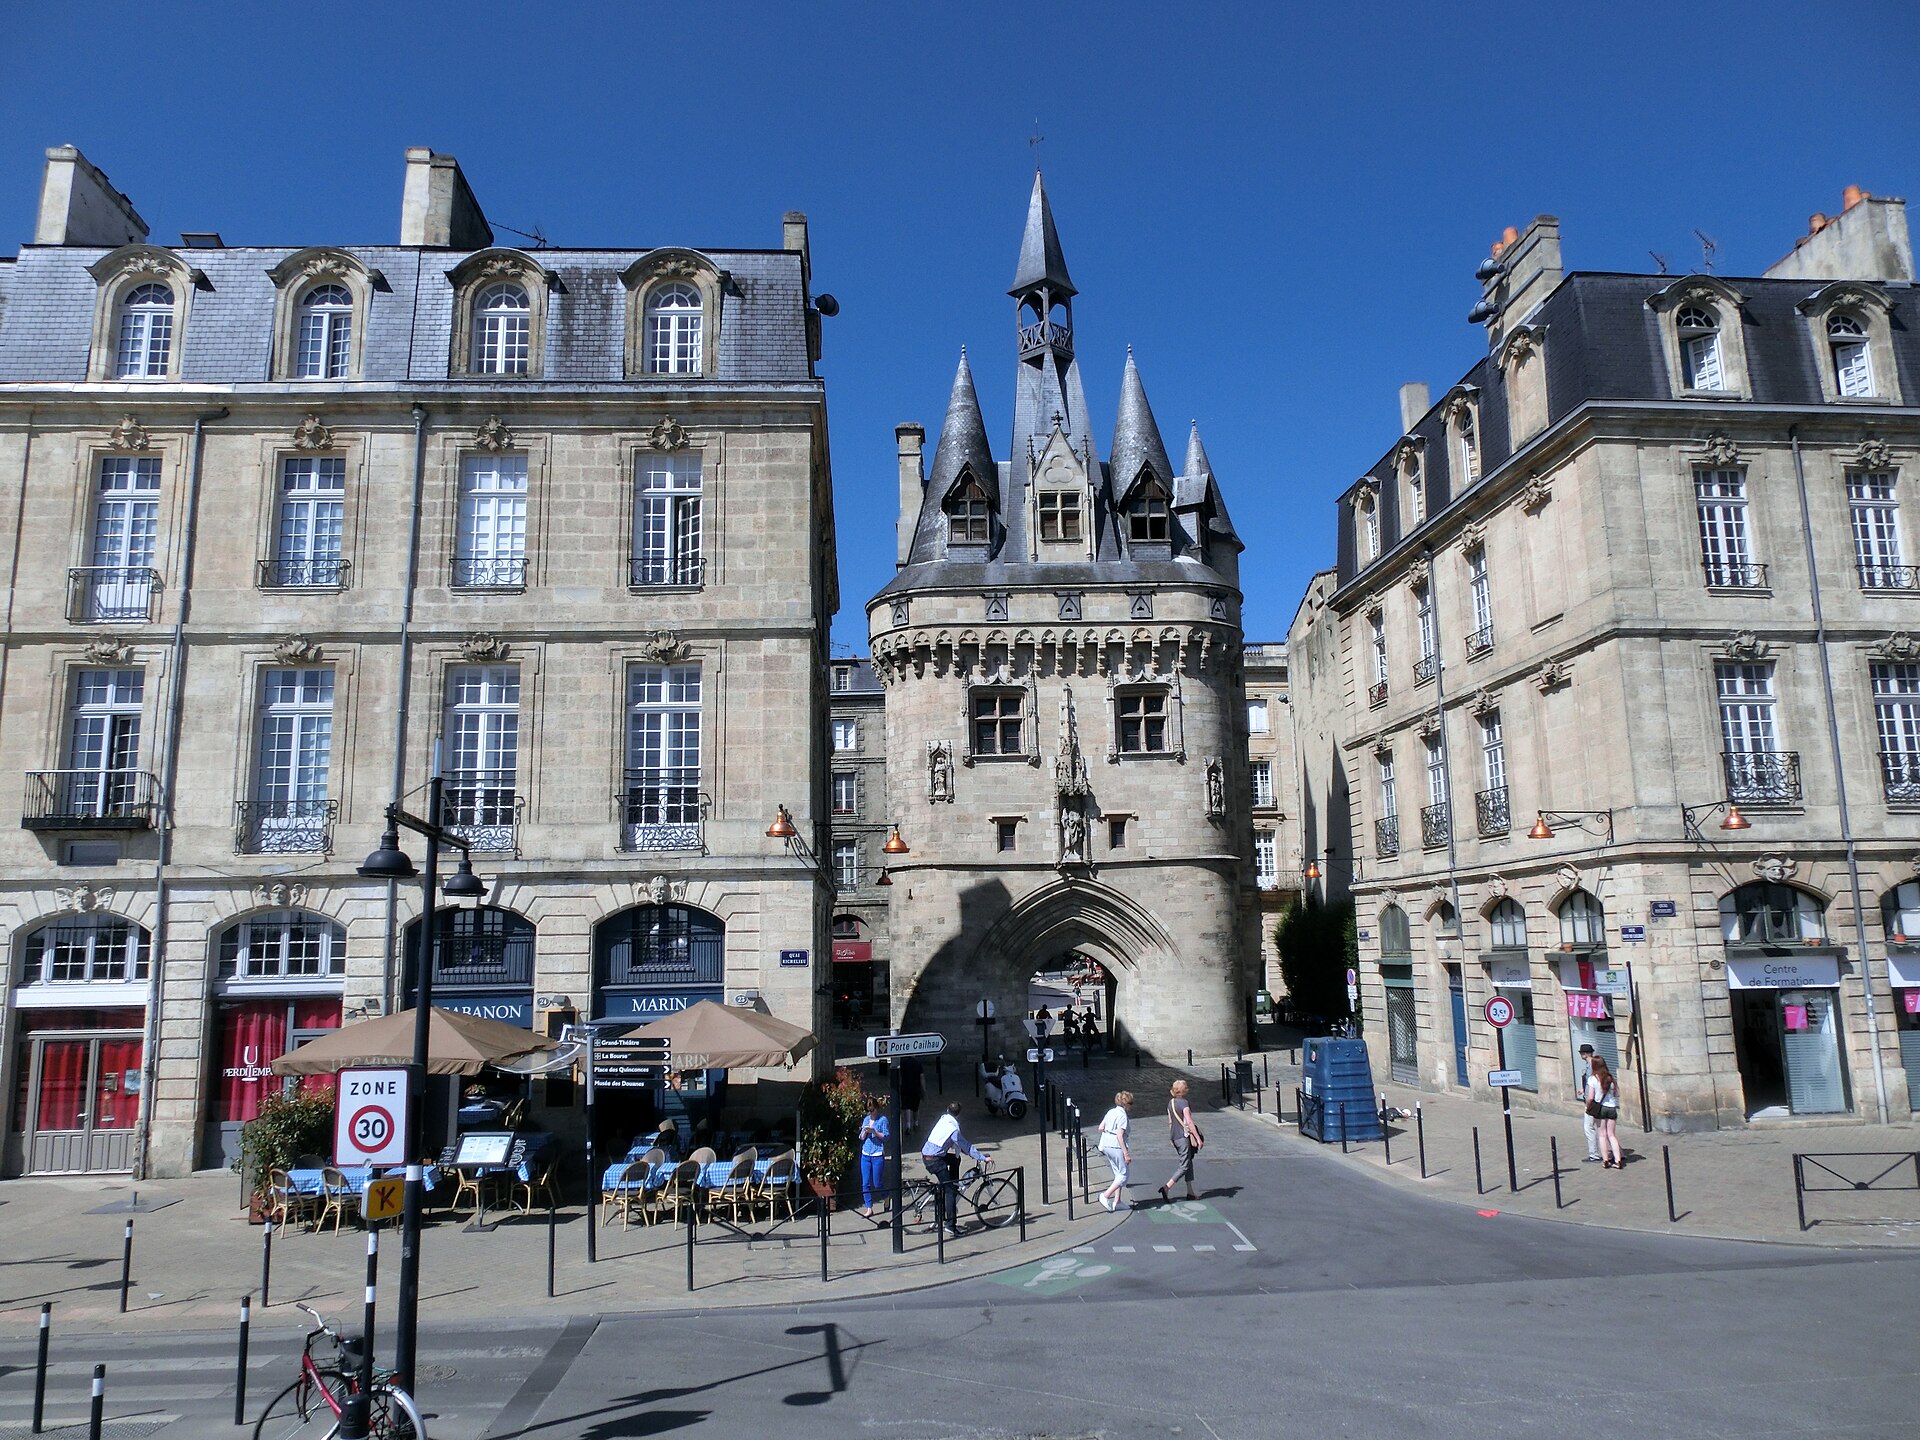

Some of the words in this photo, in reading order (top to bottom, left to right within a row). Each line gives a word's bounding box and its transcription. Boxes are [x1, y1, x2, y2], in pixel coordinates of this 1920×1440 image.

[1764, 964, 1798, 975] Centre
[1749, 977, 1761, 987] de
[1765, 977, 1815, 987] Formation
[631, 997, 688, 1012] MARIN
[443, 1005, 522, 1019] BANON
[890, 1040, 910, 1051] Porte
[913, 1040, 940, 1050] Cailhau
[222, 1064, 274, 1077] PERDITEMP
[350, 1081, 396, 1096] ZONE
[358, 1118, 385, 1139] 30
